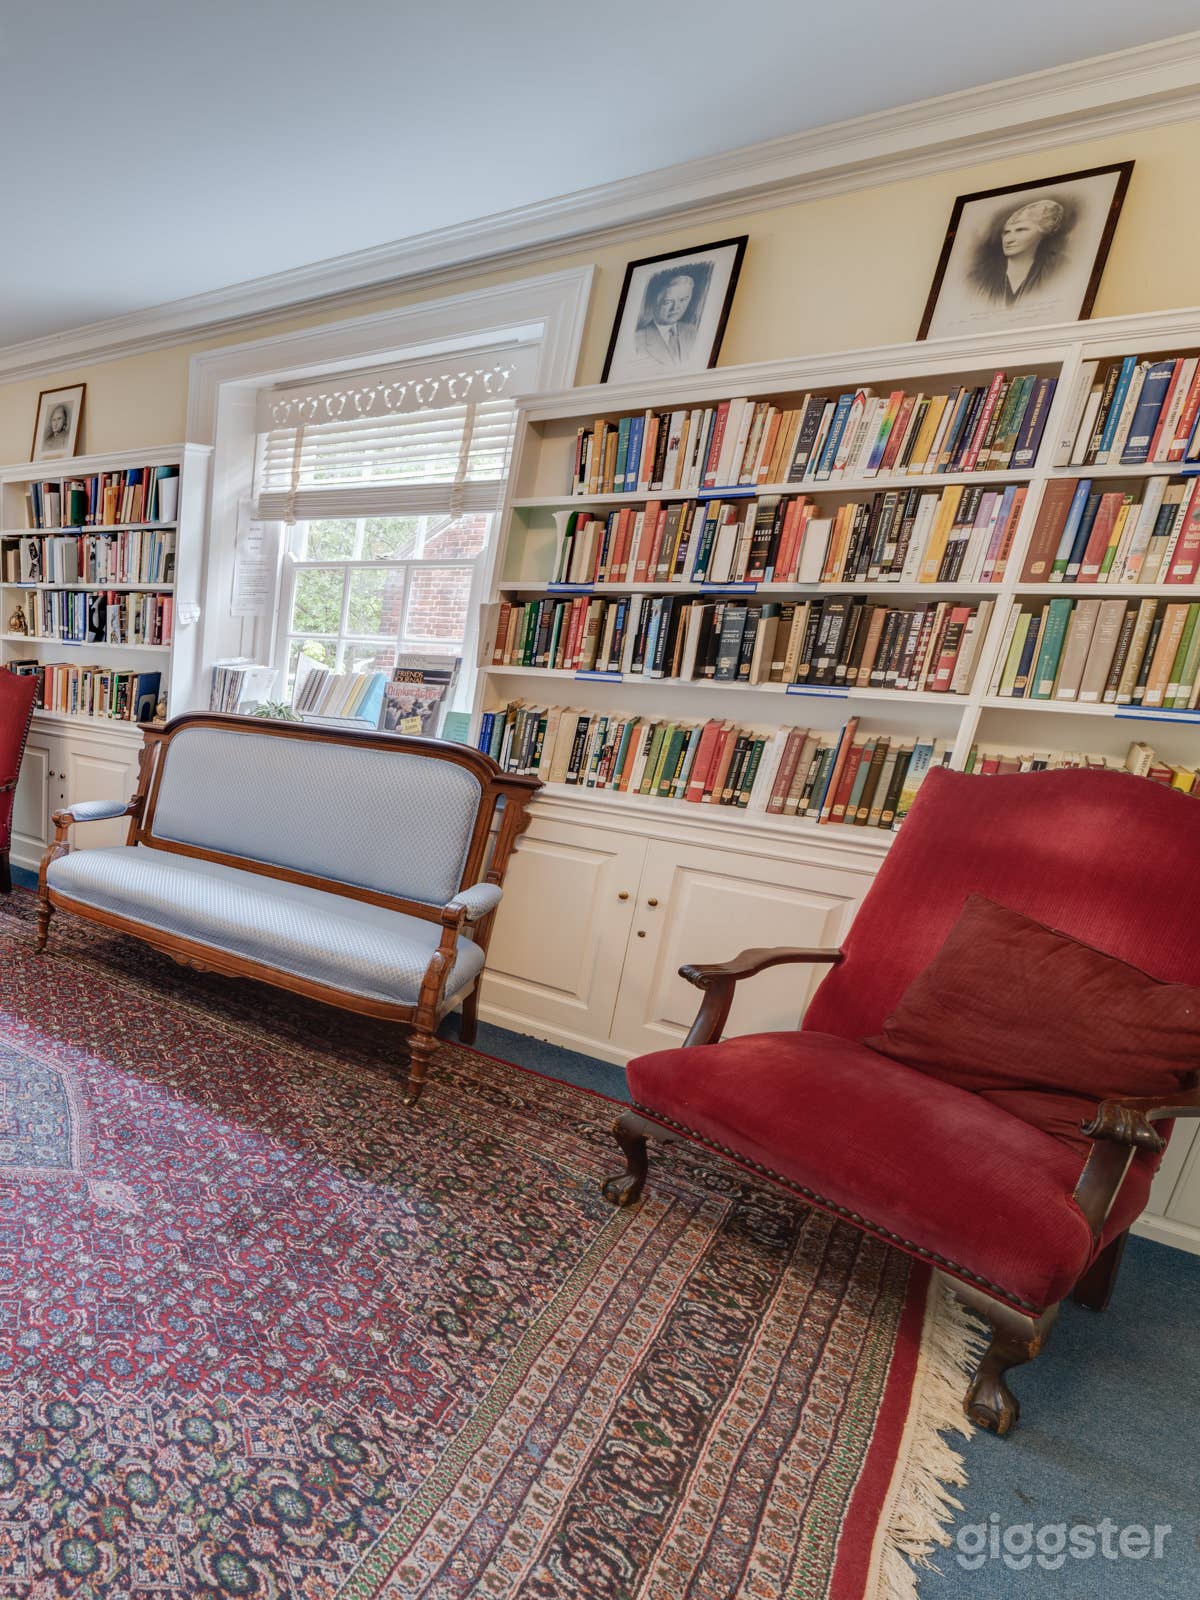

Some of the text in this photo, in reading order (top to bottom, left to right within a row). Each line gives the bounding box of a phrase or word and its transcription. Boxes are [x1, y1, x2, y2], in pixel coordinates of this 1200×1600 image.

[985, 392, 996, 409] Dying
[837, 407, 846, 420] THE
[901, 521, 911, 541] ENDING
[895, 542, 906, 564] SLAVERY
